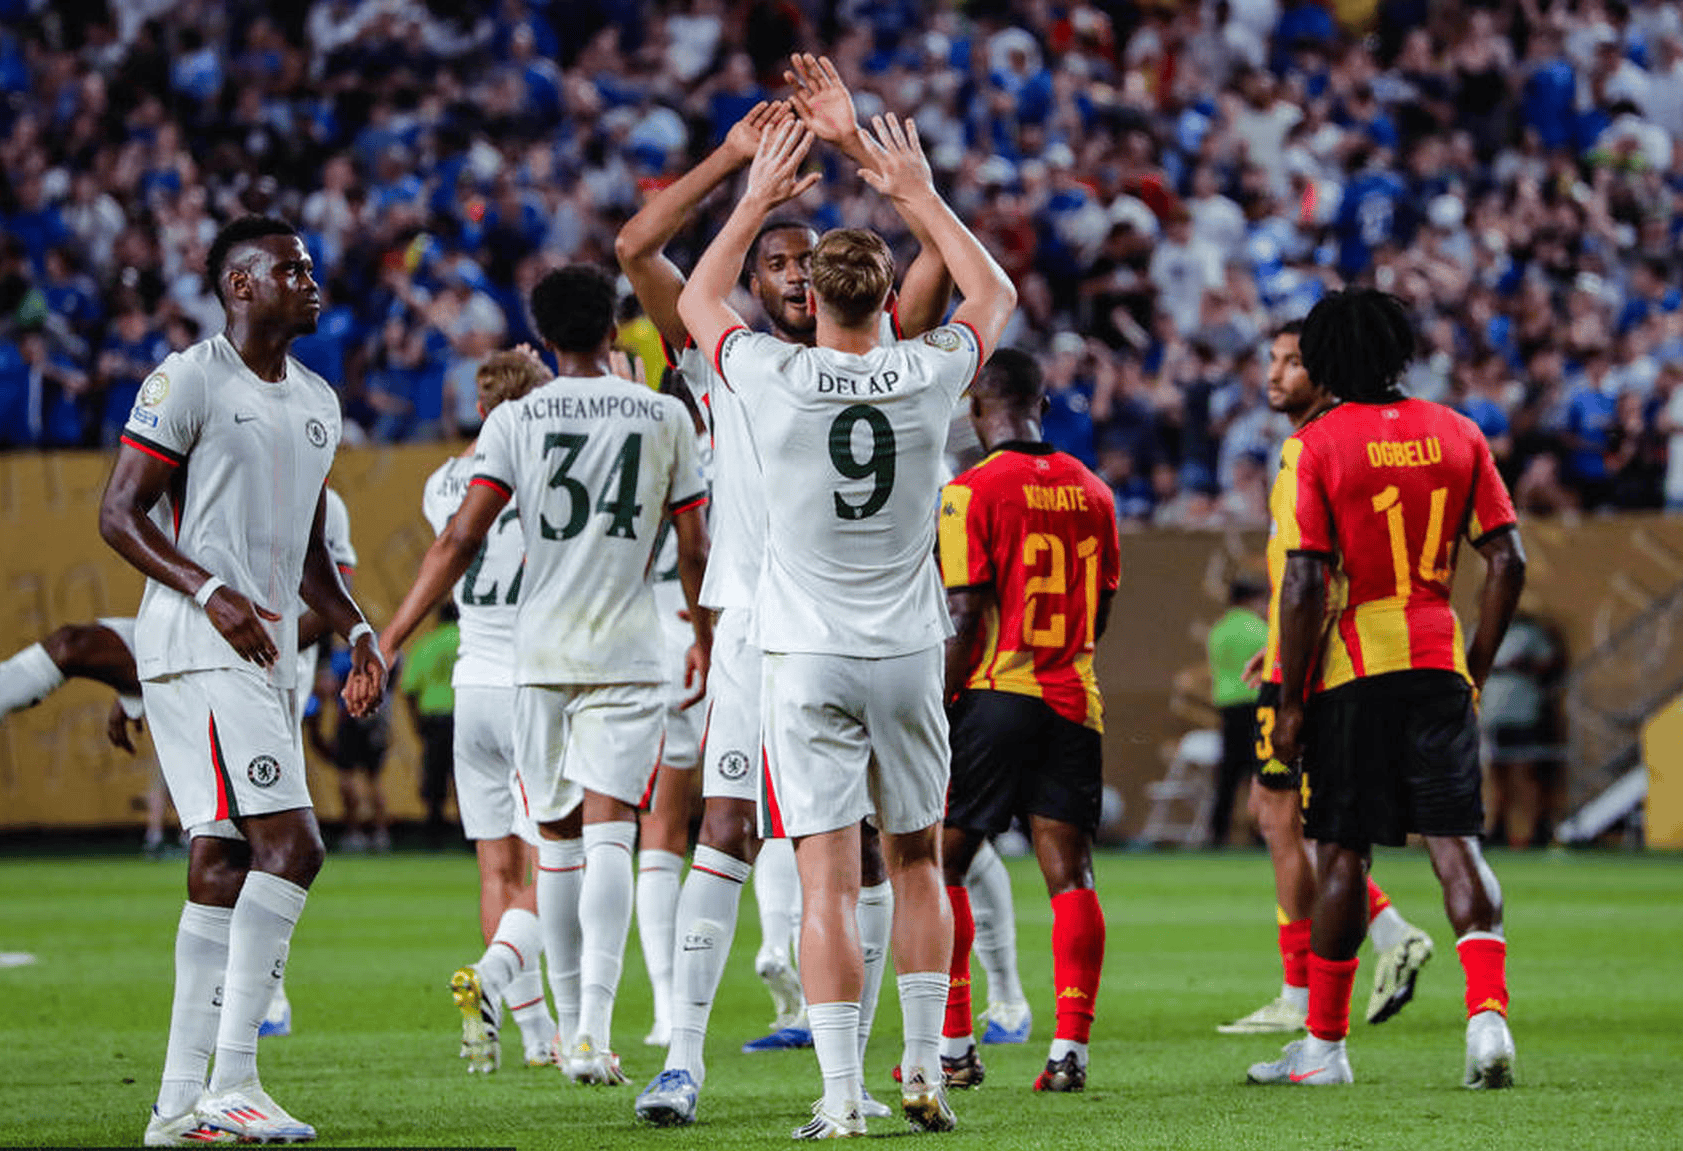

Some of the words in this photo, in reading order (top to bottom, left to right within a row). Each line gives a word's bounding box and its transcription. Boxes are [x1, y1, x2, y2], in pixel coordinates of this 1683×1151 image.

[521, 396, 665, 421] ACHEAMPONG
[817, 371, 899, 395] DELAP
[540, 432, 643, 540] 34
[828, 403, 896, 520] 9
[1366, 437, 1442, 467] OGBELU
[1022, 532, 1098, 648] 21
[1371, 484, 1451, 605] 14
